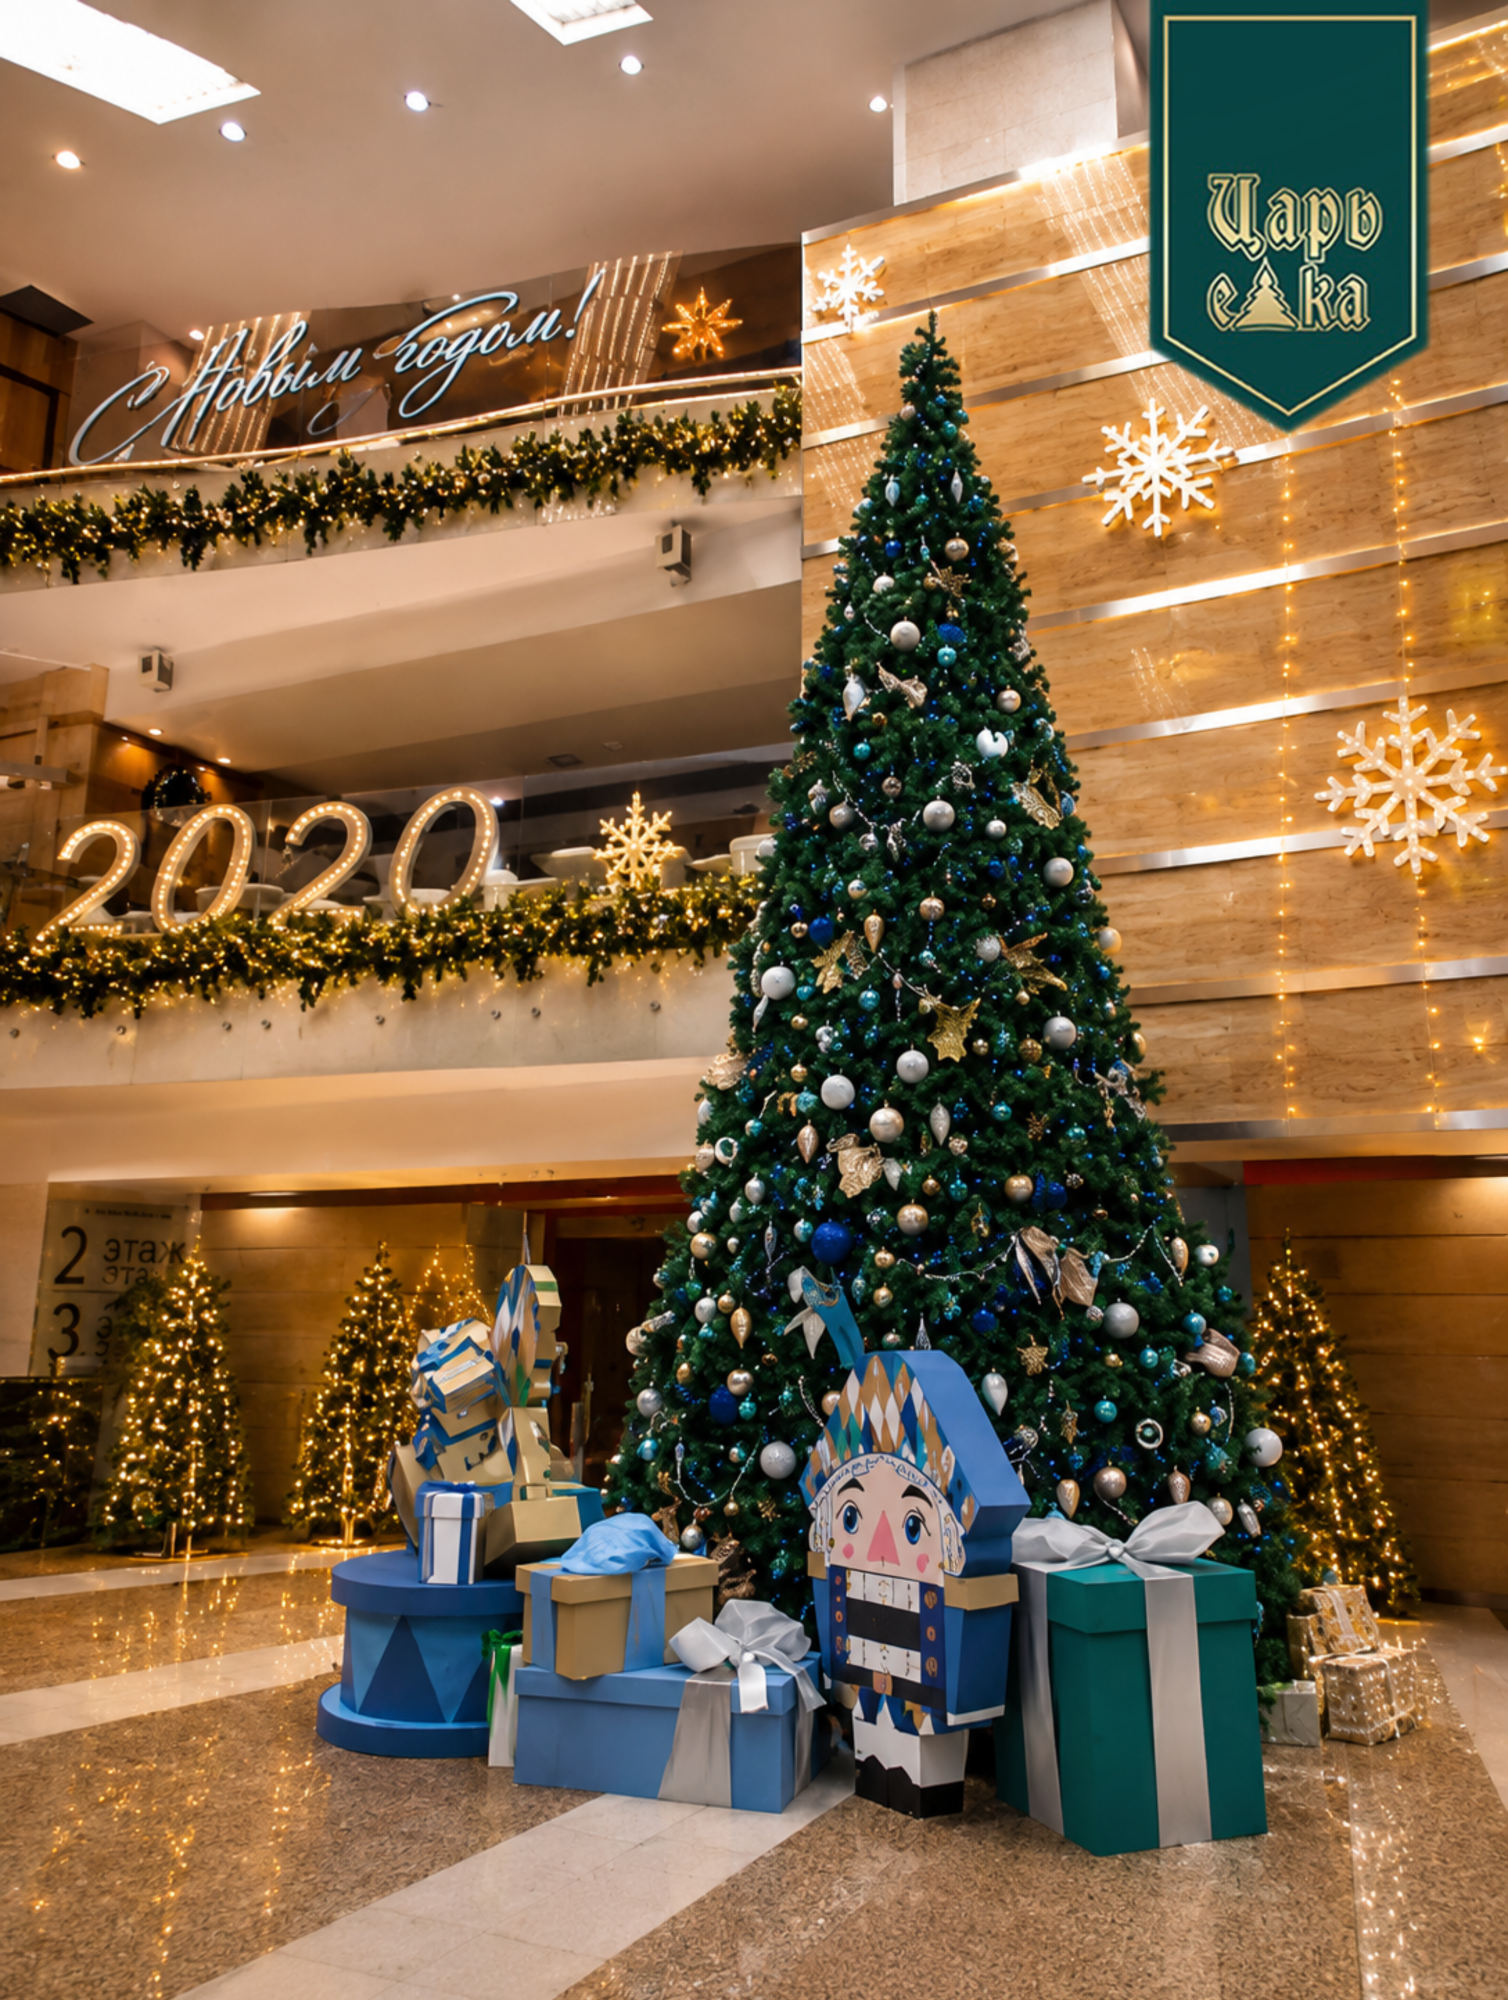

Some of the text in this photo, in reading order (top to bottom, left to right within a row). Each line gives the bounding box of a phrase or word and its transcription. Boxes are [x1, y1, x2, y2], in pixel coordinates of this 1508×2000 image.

[69, 267, 606, 466] С Новым годом!
[36, 787, 499, 942] 2020
[54, 1225, 187, 1285] 2 этаж
[48, 1302, 80, 1358] 3
